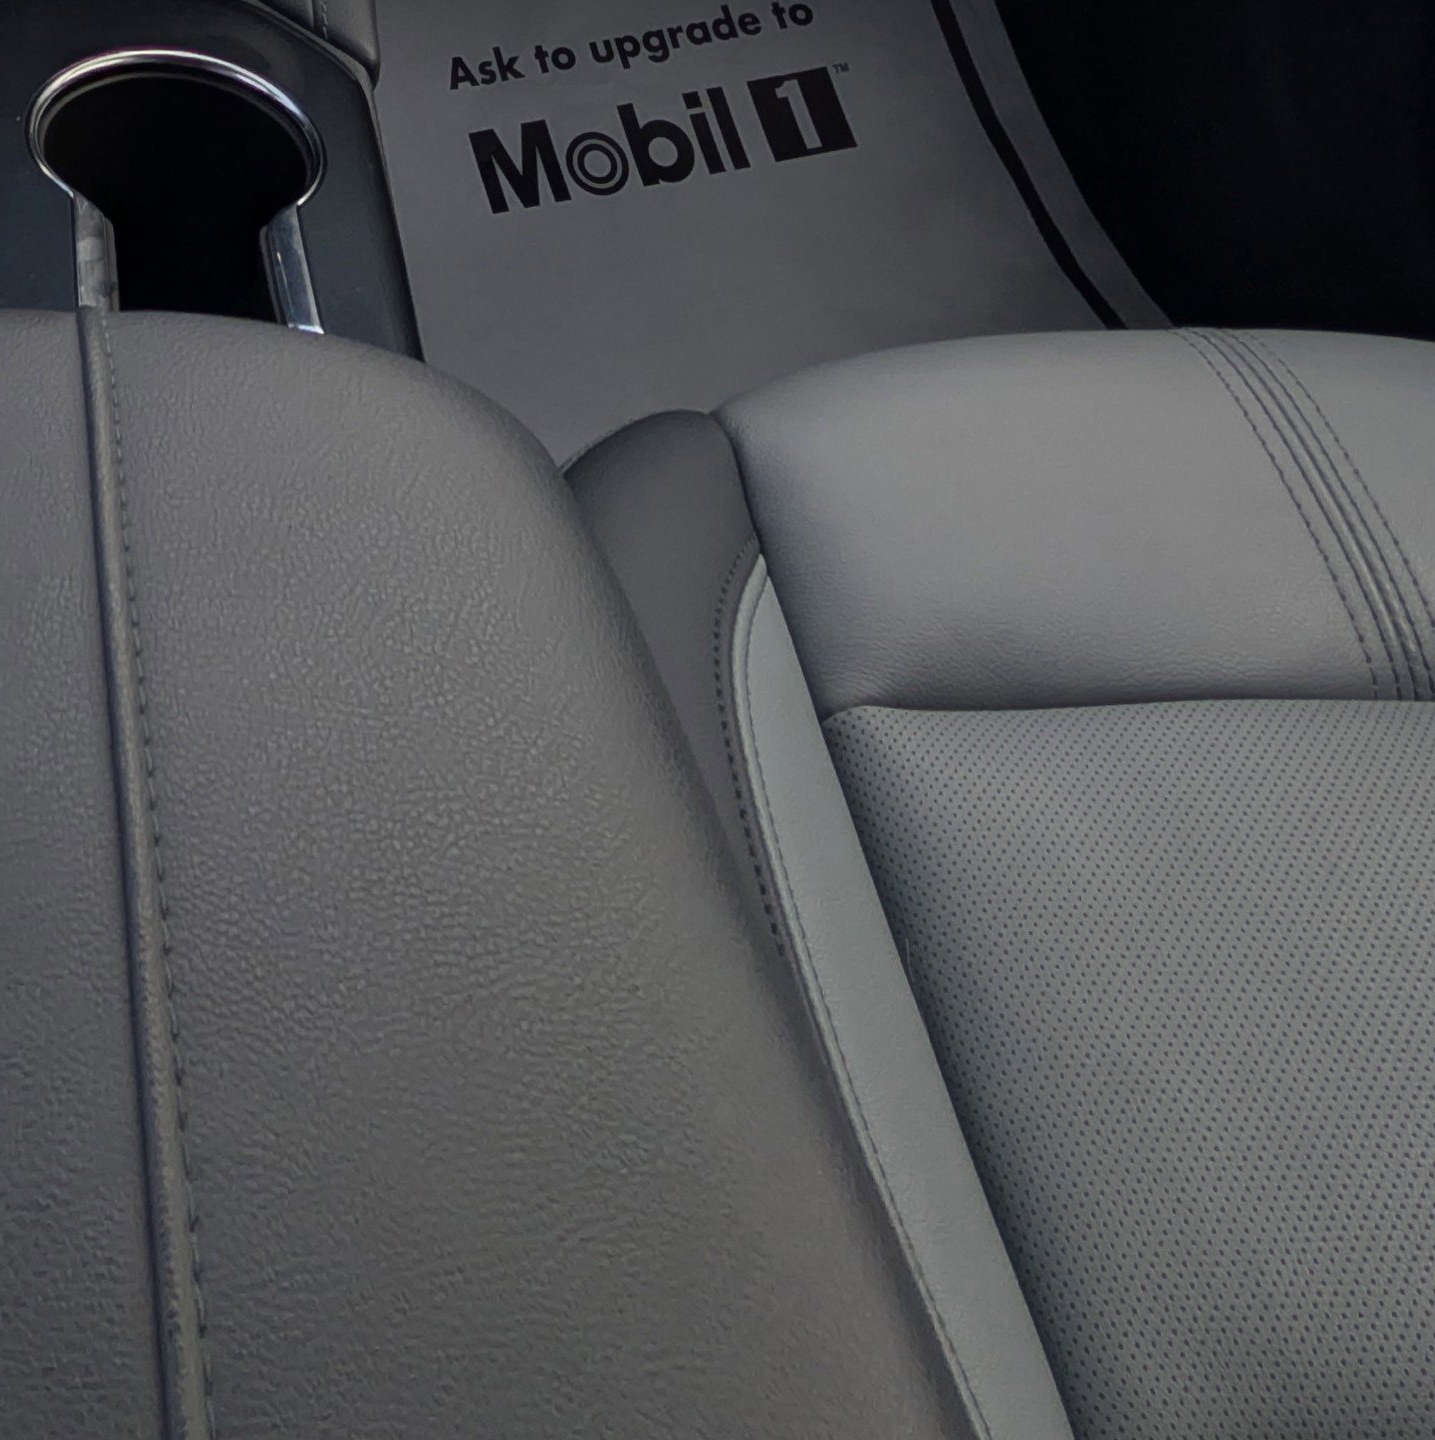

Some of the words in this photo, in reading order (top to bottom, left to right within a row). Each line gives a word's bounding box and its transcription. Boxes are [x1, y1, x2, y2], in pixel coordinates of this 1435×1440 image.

[448, 46, 526, 92] Ask
[533, 41, 578, 76] to
[588, 4, 763, 69] upgrade
[467, 85, 752, 215] Mobil
[747, 65, 858, 163] 1
